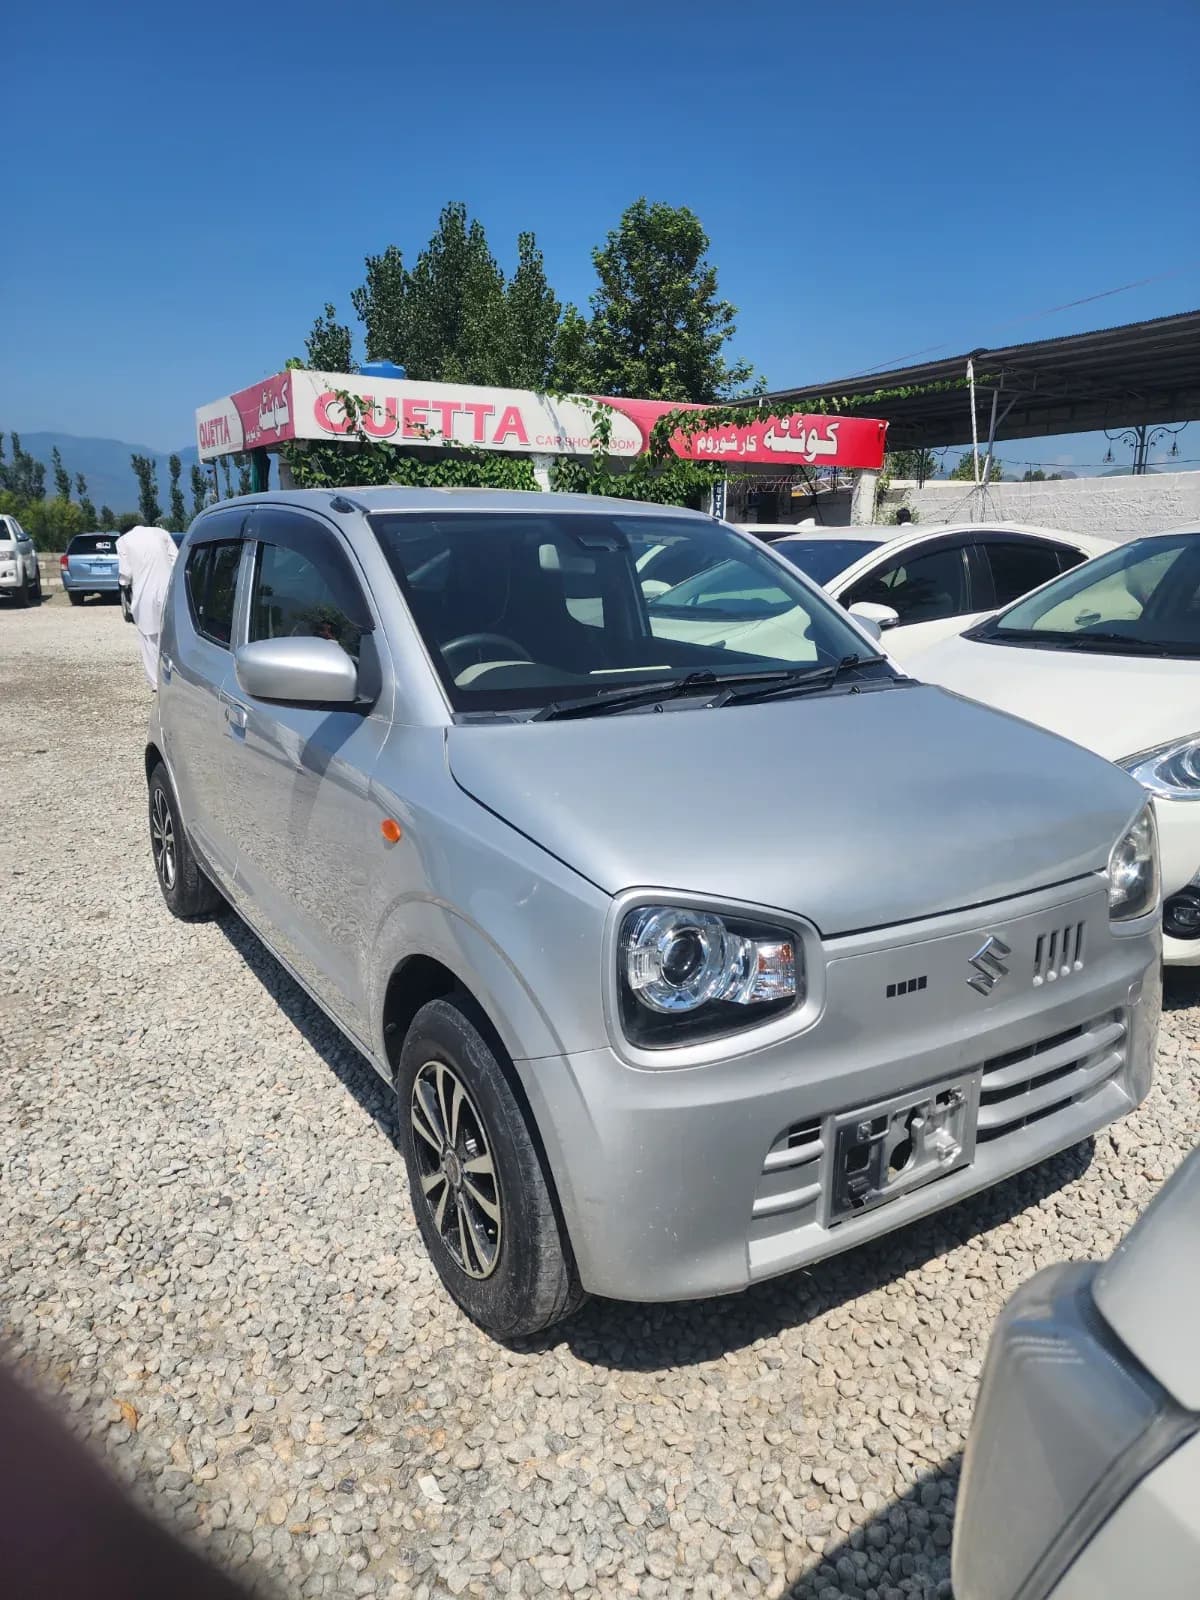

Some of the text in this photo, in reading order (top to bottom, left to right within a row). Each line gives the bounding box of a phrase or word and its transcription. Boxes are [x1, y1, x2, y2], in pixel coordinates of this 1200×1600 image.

[199, 415, 231, 449] QUETTA
[314, 390, 530, 446] QUETTA
[697, 432, 737, 454] شوروم
[738, 434, 757, 455] کار
